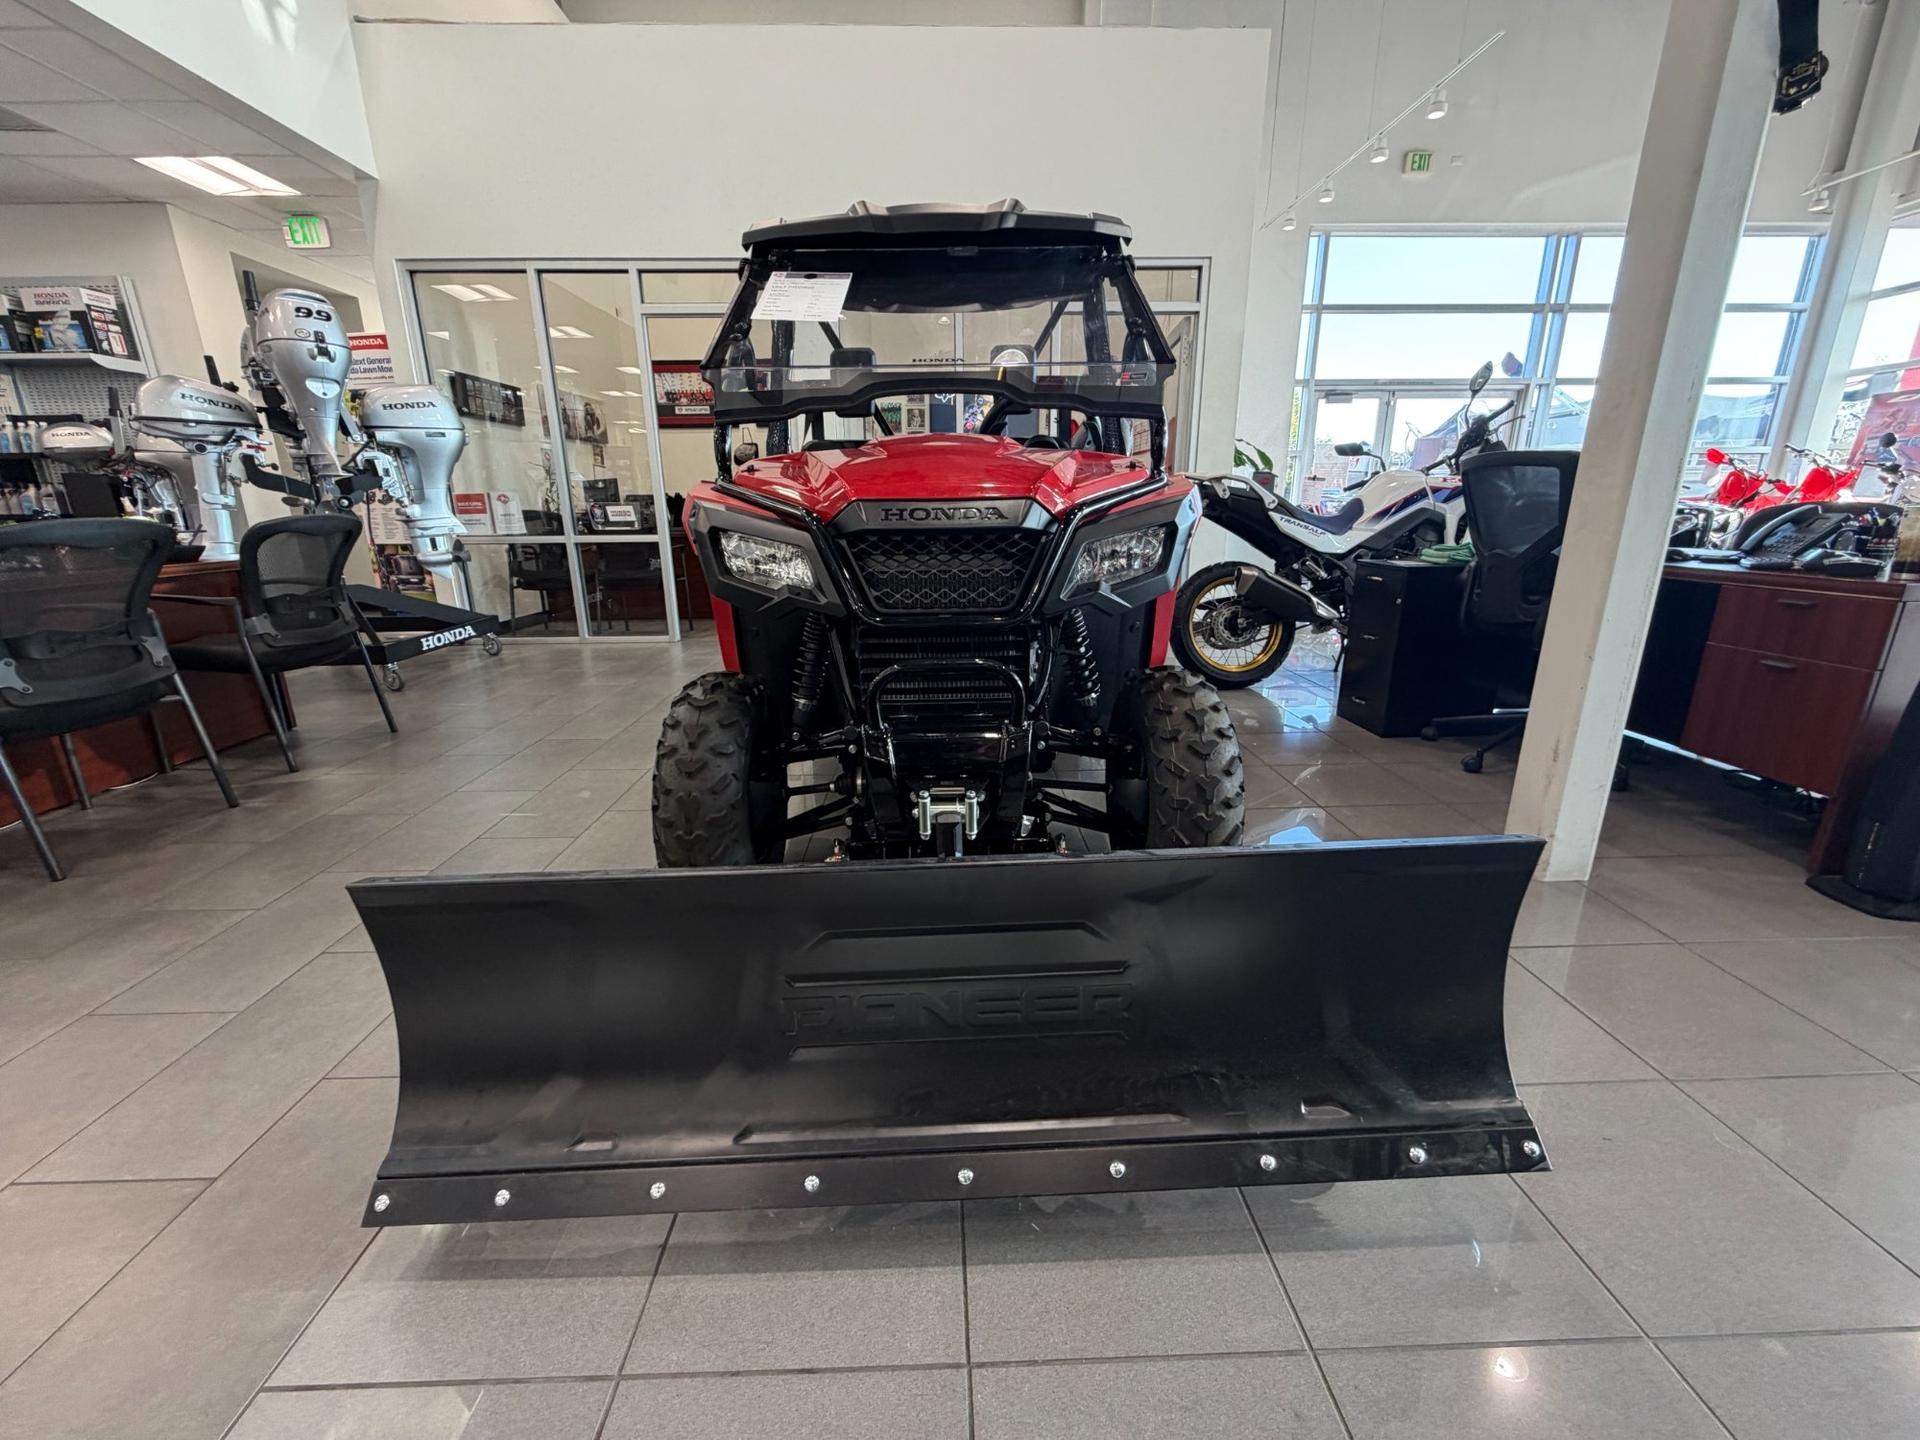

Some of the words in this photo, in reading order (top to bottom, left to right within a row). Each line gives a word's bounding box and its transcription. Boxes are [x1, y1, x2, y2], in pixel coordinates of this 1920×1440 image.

[1411, 153, 1432, 171] EXIT
[288, 218, 320, 244] EXIT
[349, 337, 384, 346] HONDA
[179, 392, 245, 413] HONDA
[381, 401, 437, 411] HONDA
[880, 506, 1009, 522] HONDA
[1279, 516, 1327, 536] TRANSALP
[420, 625, 477, 651] HONDA
[780, 983, 1133, 1037] PIONEER
